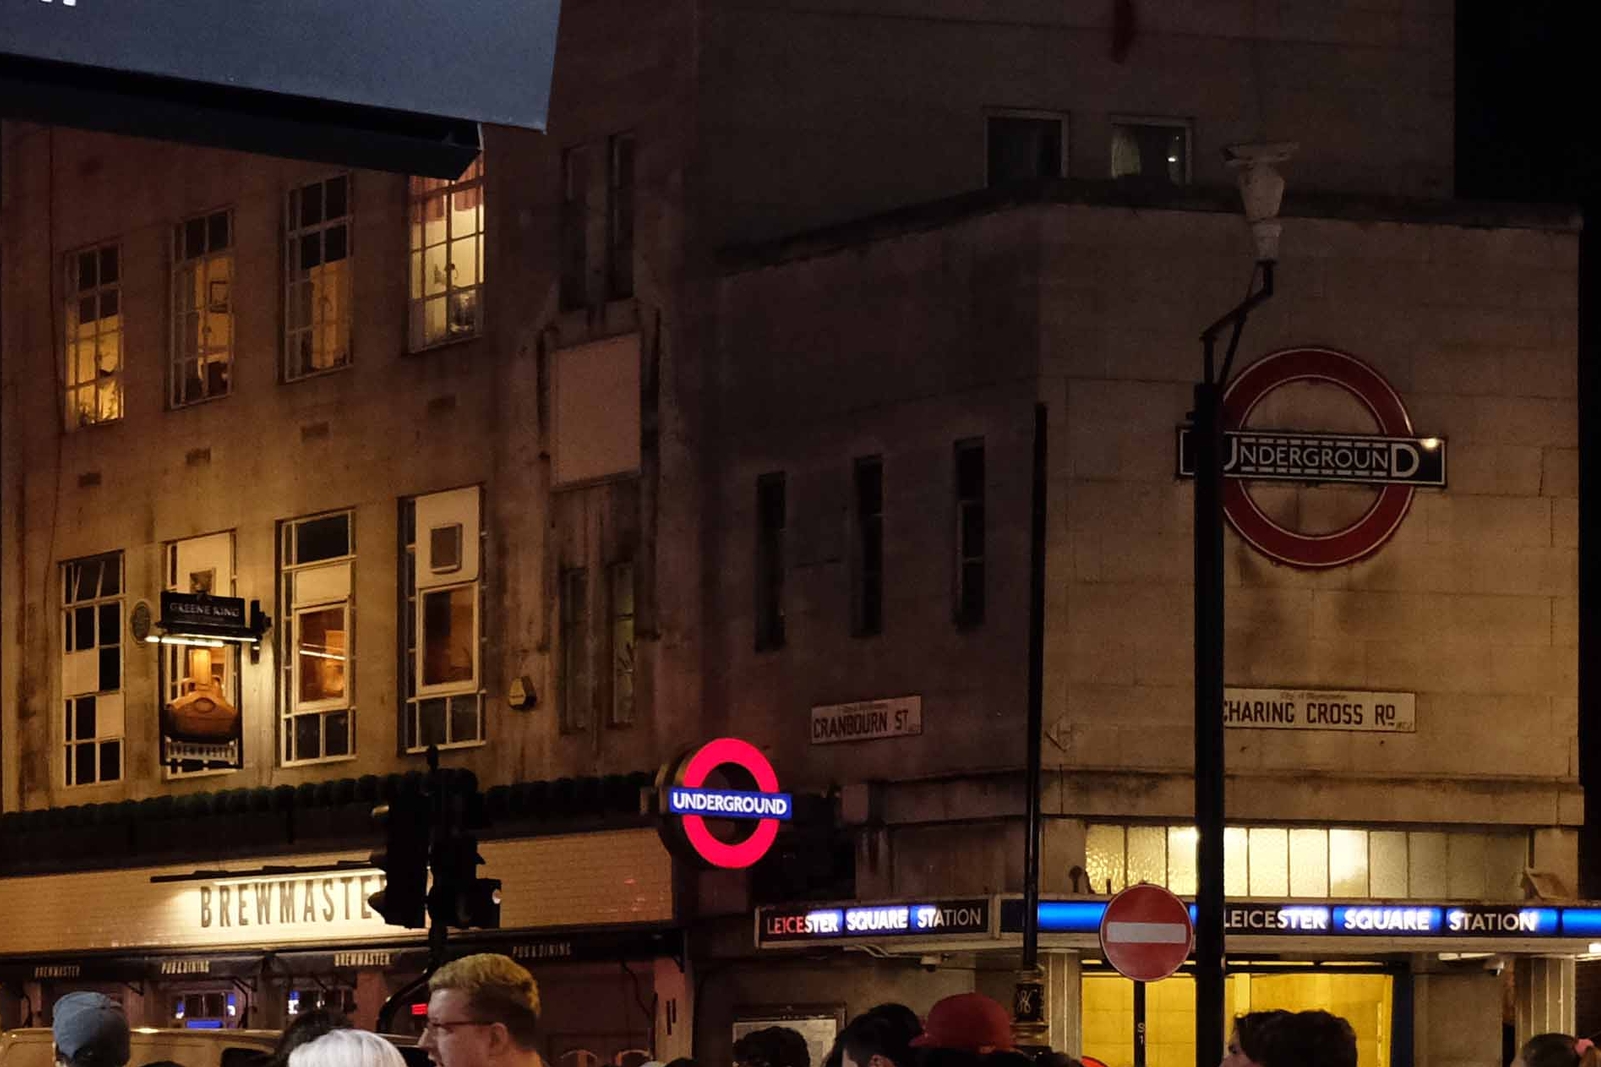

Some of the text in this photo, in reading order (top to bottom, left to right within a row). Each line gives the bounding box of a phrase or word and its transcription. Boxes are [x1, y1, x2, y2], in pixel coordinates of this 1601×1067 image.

[213, 606, 240, 618] KING
[813, 709, 909, 738] CRANBOURN ST
[1306, 702, 1363, 725] CROSS
[672, 792, 788, 815] UNDERGROUND
[766, 907, 982, 935] LEICESTER SQUARE STATION
[1343, 909, 1431, 931] SQUARE
[1448, 909, 1539, 932] STATION
